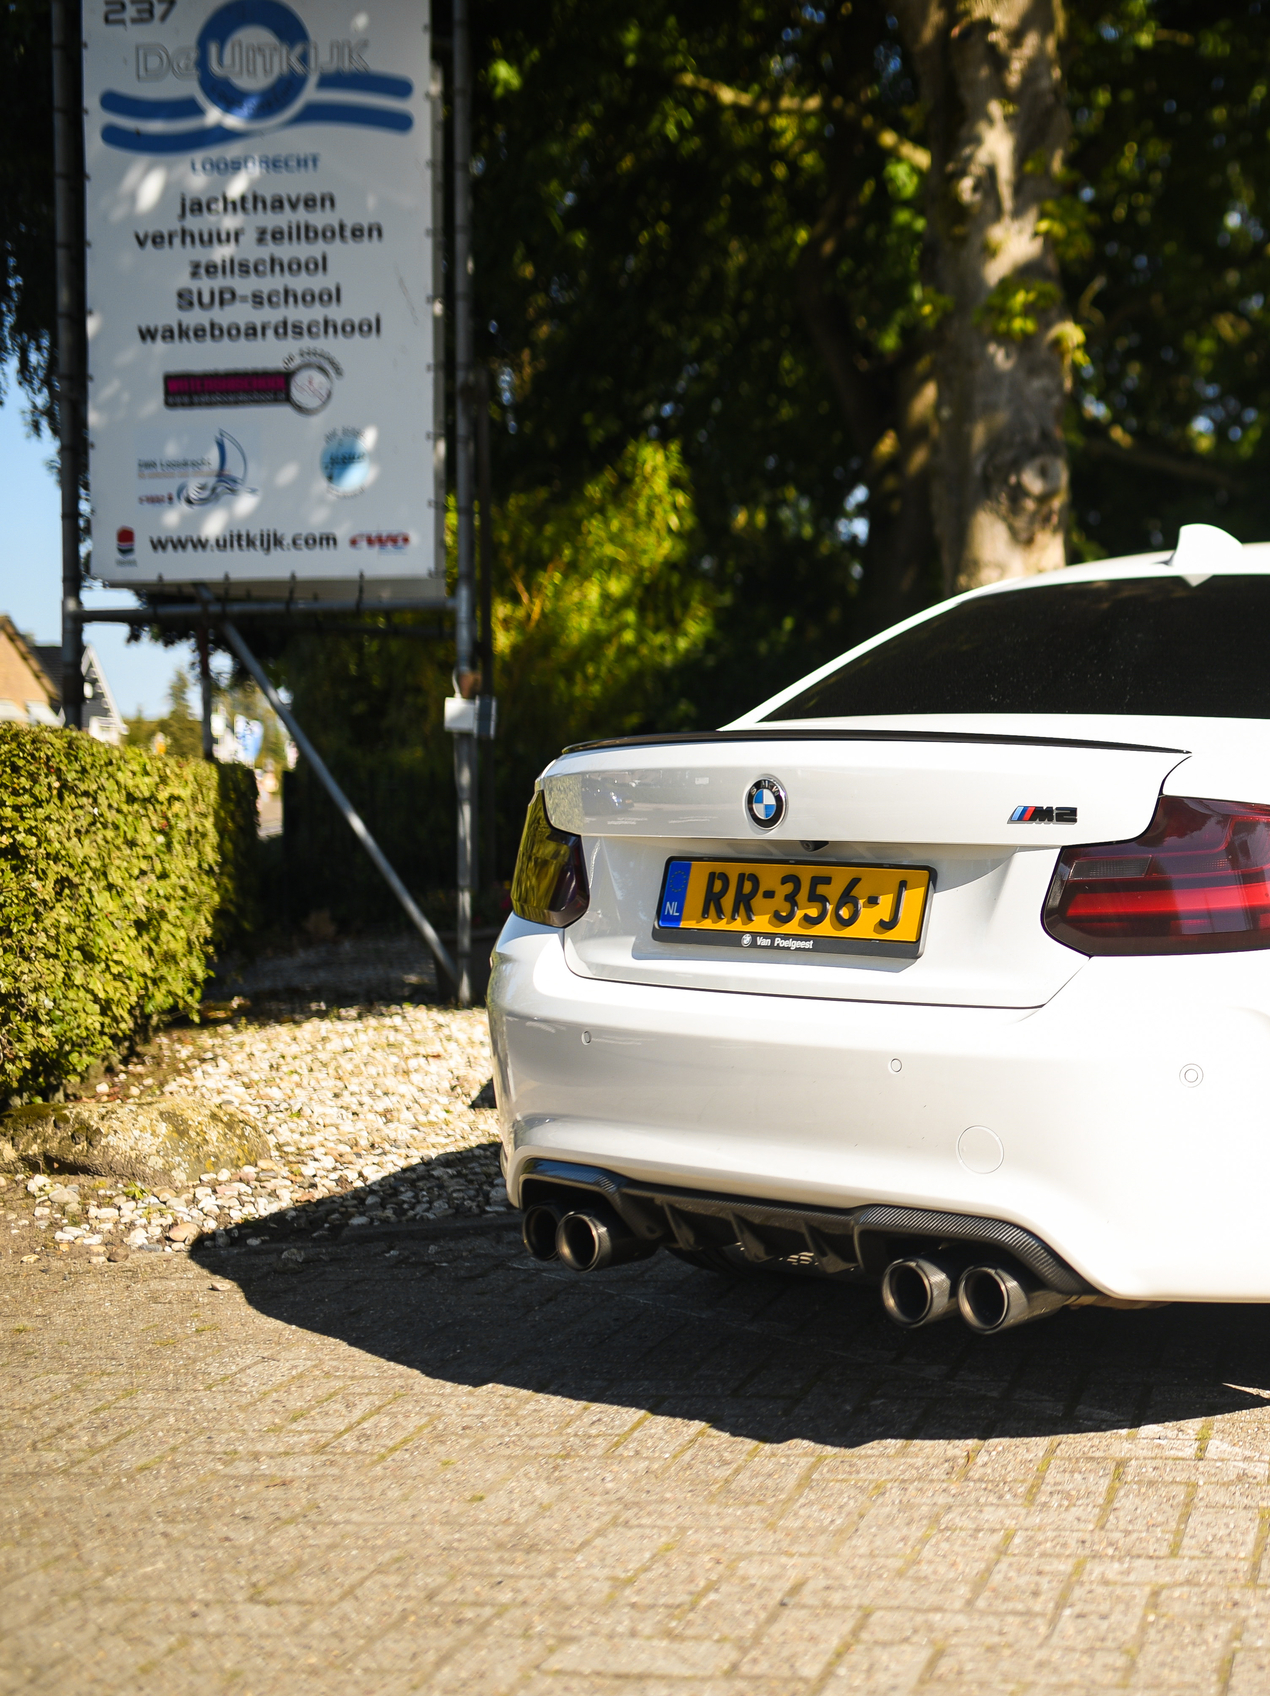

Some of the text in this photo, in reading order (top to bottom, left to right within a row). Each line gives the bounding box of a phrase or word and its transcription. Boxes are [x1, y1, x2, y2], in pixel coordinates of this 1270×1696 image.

[104, 0, 176, 26] 237
[177, 191, 336, 220] jachthaven
[134, 221, 383, 251] verhuur zeilboten
[189, 252, 328, 280] zeilschool
[176, 282, 342, 312] SUP-school
[138, 313, 382, 344] wakeboardschool
[150, 530, 338, 556] www.uitkijk.com
[664, 871, 908, 931] NL RR-356-J
[757, 936, 772, 947] Van
[774, 937, 814, 950] Poelgeest
